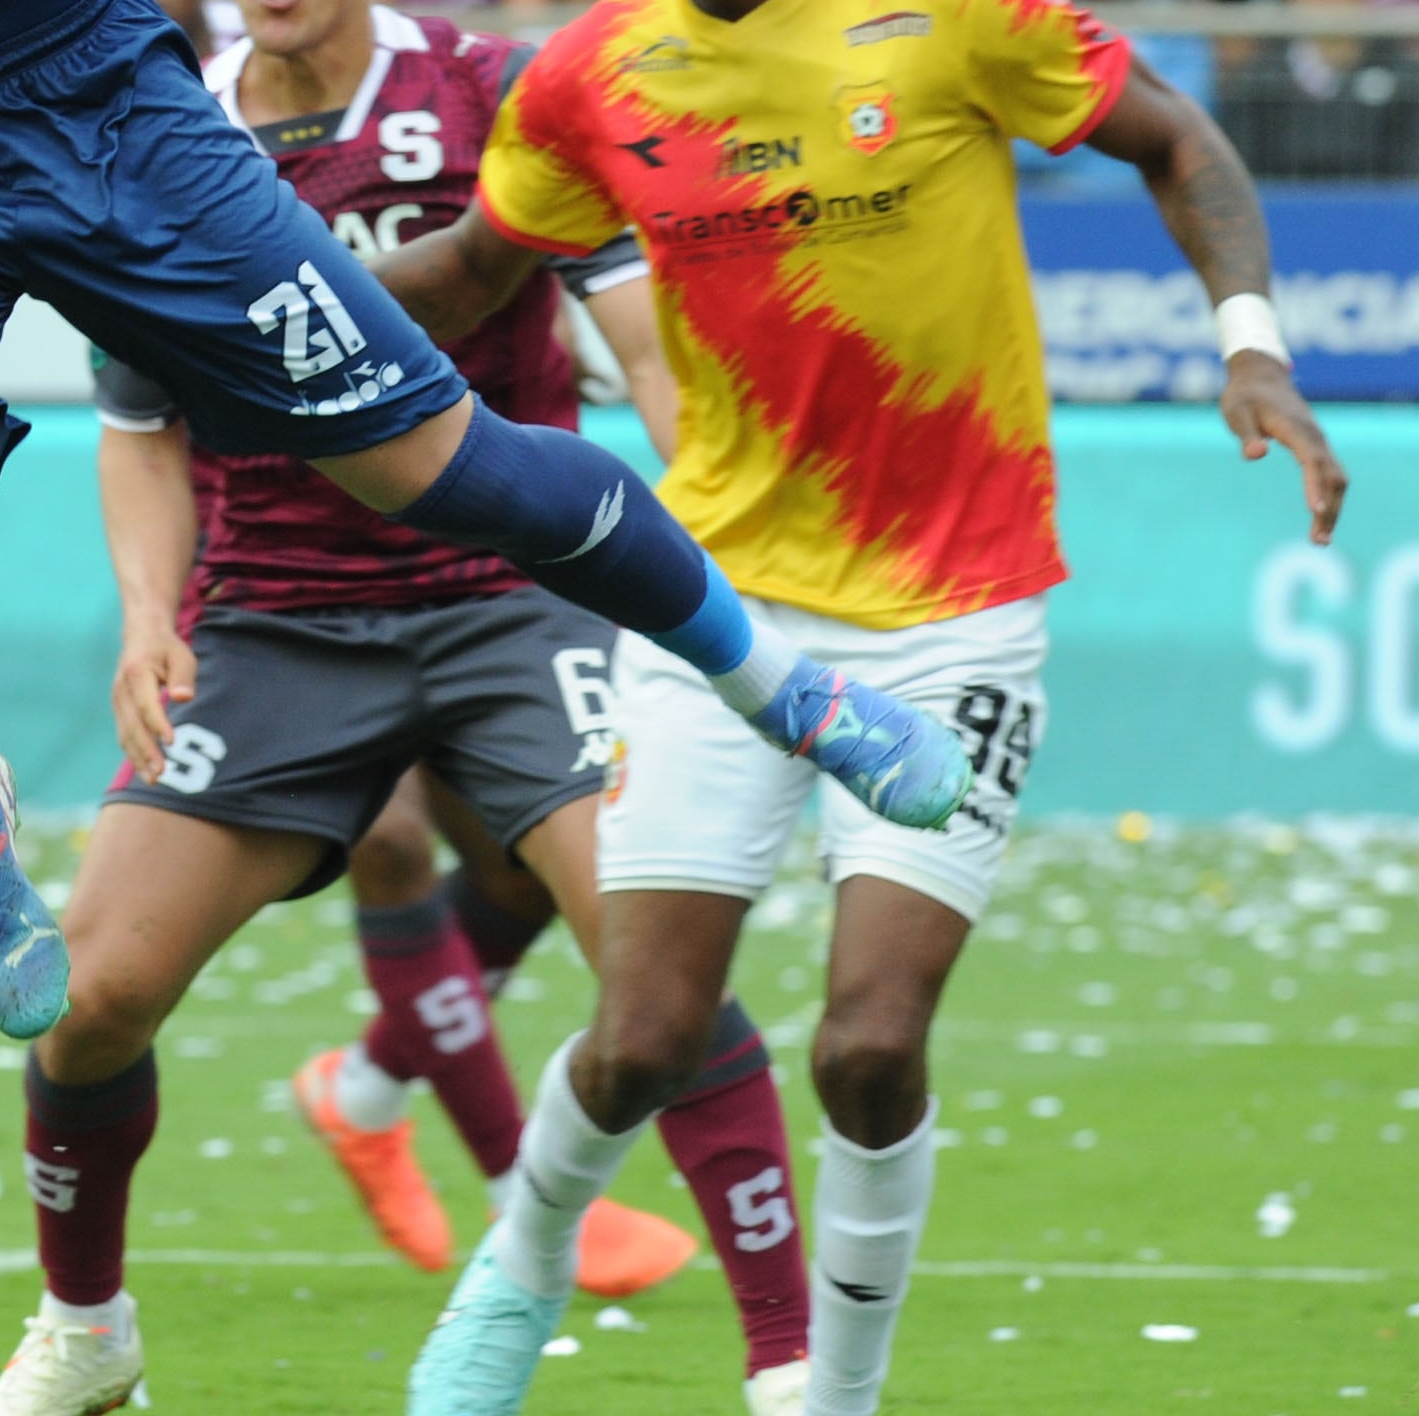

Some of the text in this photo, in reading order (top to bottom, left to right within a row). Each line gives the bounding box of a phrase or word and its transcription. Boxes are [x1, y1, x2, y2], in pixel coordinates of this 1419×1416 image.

[377, 110, 444, 182] S
[247, 260, 368, 383] 21
[551, 647, 621, 735] 6
[158, 722, 228, 795] S
[415, 976, 488, 1055] S
[23, 1151, 81, 1213] S
[725, 1166, 794, 1253] S
